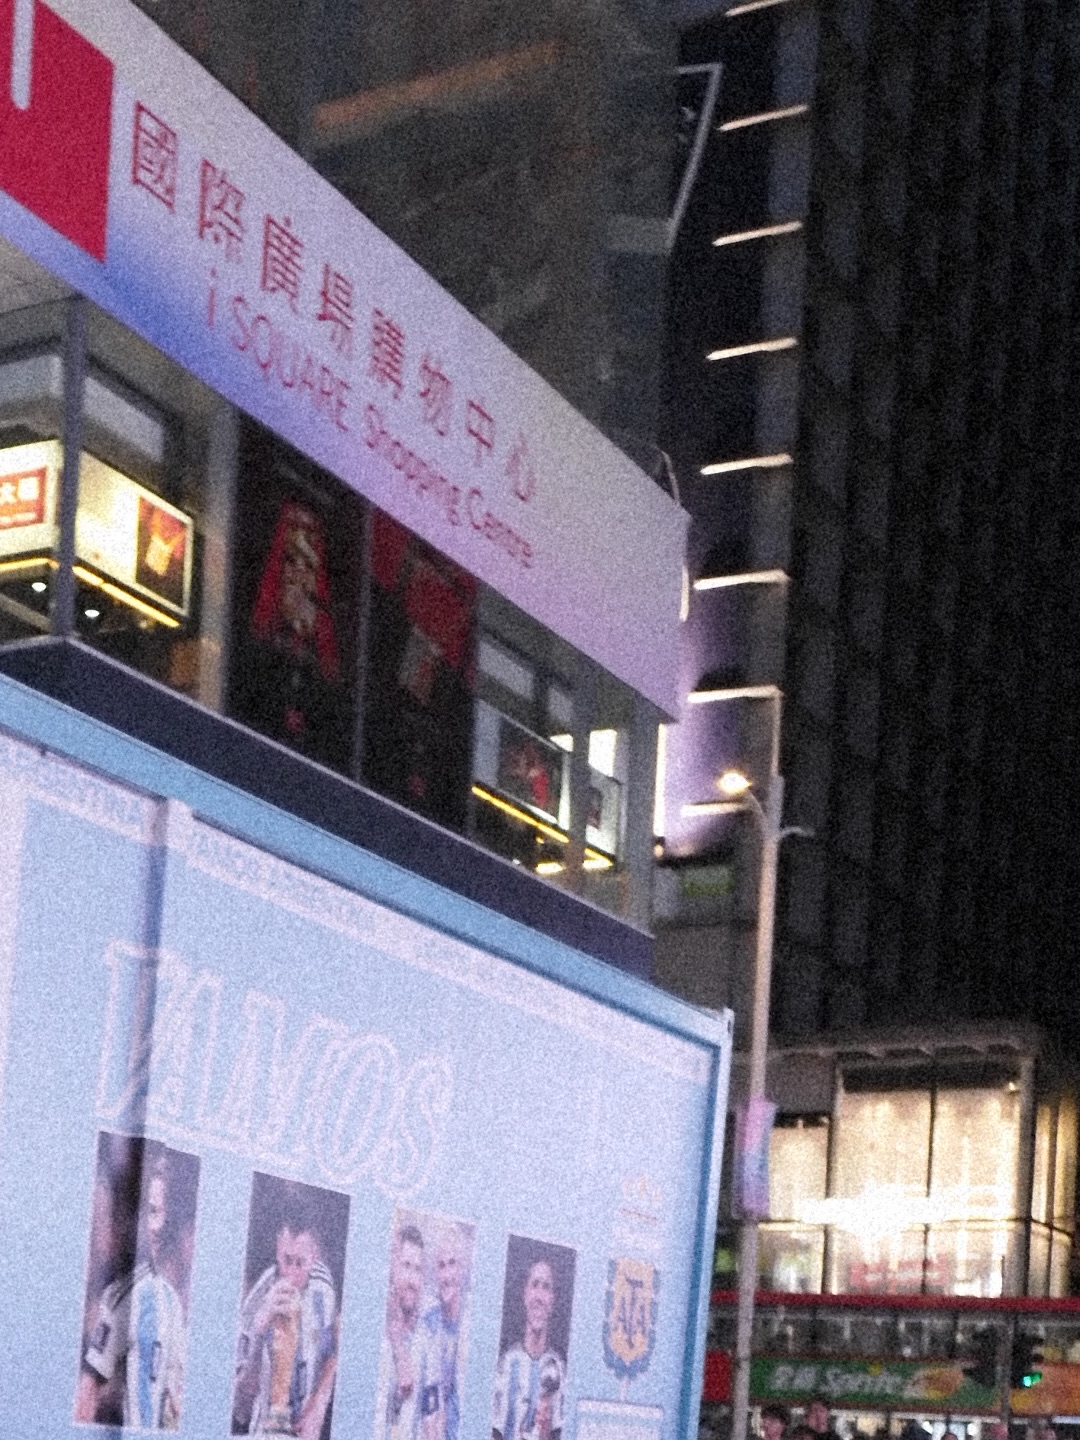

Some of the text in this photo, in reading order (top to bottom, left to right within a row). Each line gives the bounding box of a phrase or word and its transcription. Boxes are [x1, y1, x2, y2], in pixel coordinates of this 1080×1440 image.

[131, 101, 536, 502] 國際廣場購物中心
[363, 403, 462, 527] Shopping
[466, 487, 533, 569] Centre
[94, 936, 455, 1199] VAMOS
